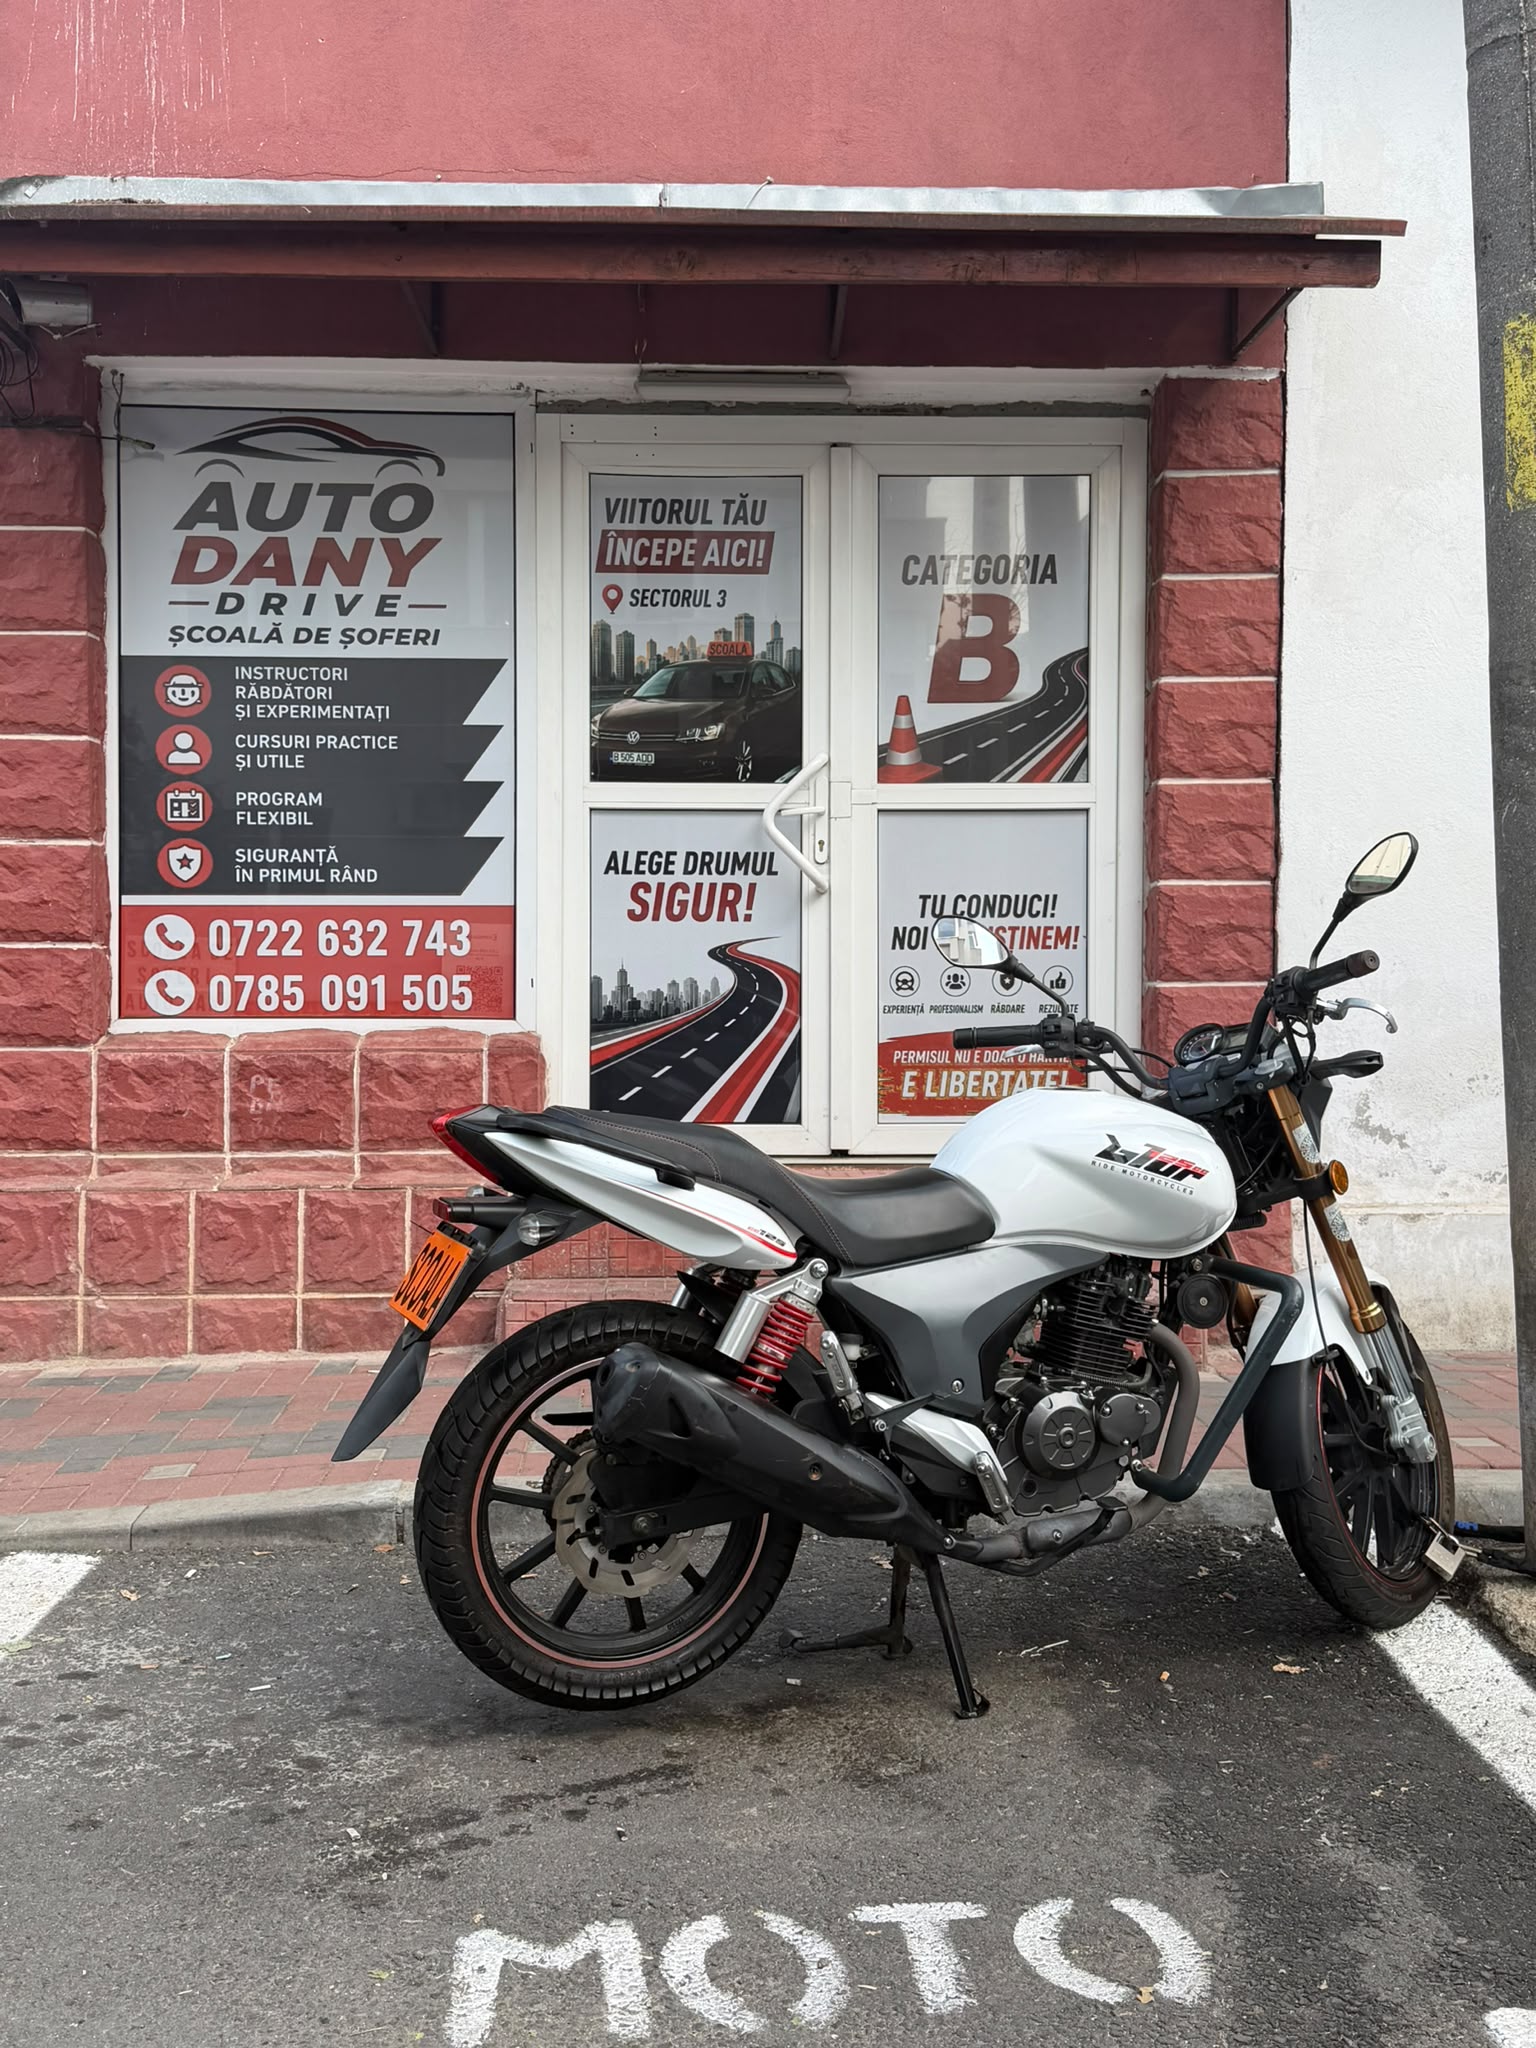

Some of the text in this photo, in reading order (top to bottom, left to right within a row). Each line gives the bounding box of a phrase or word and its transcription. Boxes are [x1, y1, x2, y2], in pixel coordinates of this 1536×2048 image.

[173, 481, 434, 534] AUTO
[605, 492, 767, 526] VIITORUL TĂU
[170, 535, 443, 587] DANY
[605, 531, 766, 568] ÎNCEPE AICI!
[902, 554, 1058, 586] CATEGORIA
[215, 592, 402, 617] DRIVE
[629, 588, 727, 608] SECTORUL 3
[168, 622, 440, 649] ȘCOALĂ DE ȘOFERI
[927, 593, 1020, 704] B
[235, 666, 348, 681] INSTRUCTORI
[235, 684, 333, 700] RĂBDĂTORI
[235, 705, 390, 722] ȘI EXPERIMENTAȚI
[235, 735, 398, 751] CURSURI PRACTICE
[235, 754, 305, 770] ȘI UTILE
[236, 792, 323, 807] PROGRAM
[236, 811, 313, 826] FLEXIBIL
[235, 846, 338, 866] SIGURANȚĂ
[604, 850, 778, 876] ALEGE DRUMUL
[235, 866, 378, 884] ÎN PRIMUL RÂND
[626, 881, 757, 923] SIGUR!
[919, 894, 1058, 918] TU CONDUCI!
[208, 919, 302, 957] 0722
[317, 919, 388, 957] 632
[402, 919, 471, 957] 743
[891, 926, 928, 950] NOI
[209, 974, 304, 1012] 0785
[321, 974, 386, 1012] 091
[402, 974, 473, 1012] 505
[929, 1004, 984, 1014] PROFESIONALISM
[893, 1050, 950, 1064] PERMISUL
[954, 1050, 971, 1064] NU
[974, 1051, 981, 1063] E
[902, 1070, 916, 1097] E
[1091, 1160, 1194, 1195] RIDE MOTORCYCLES
